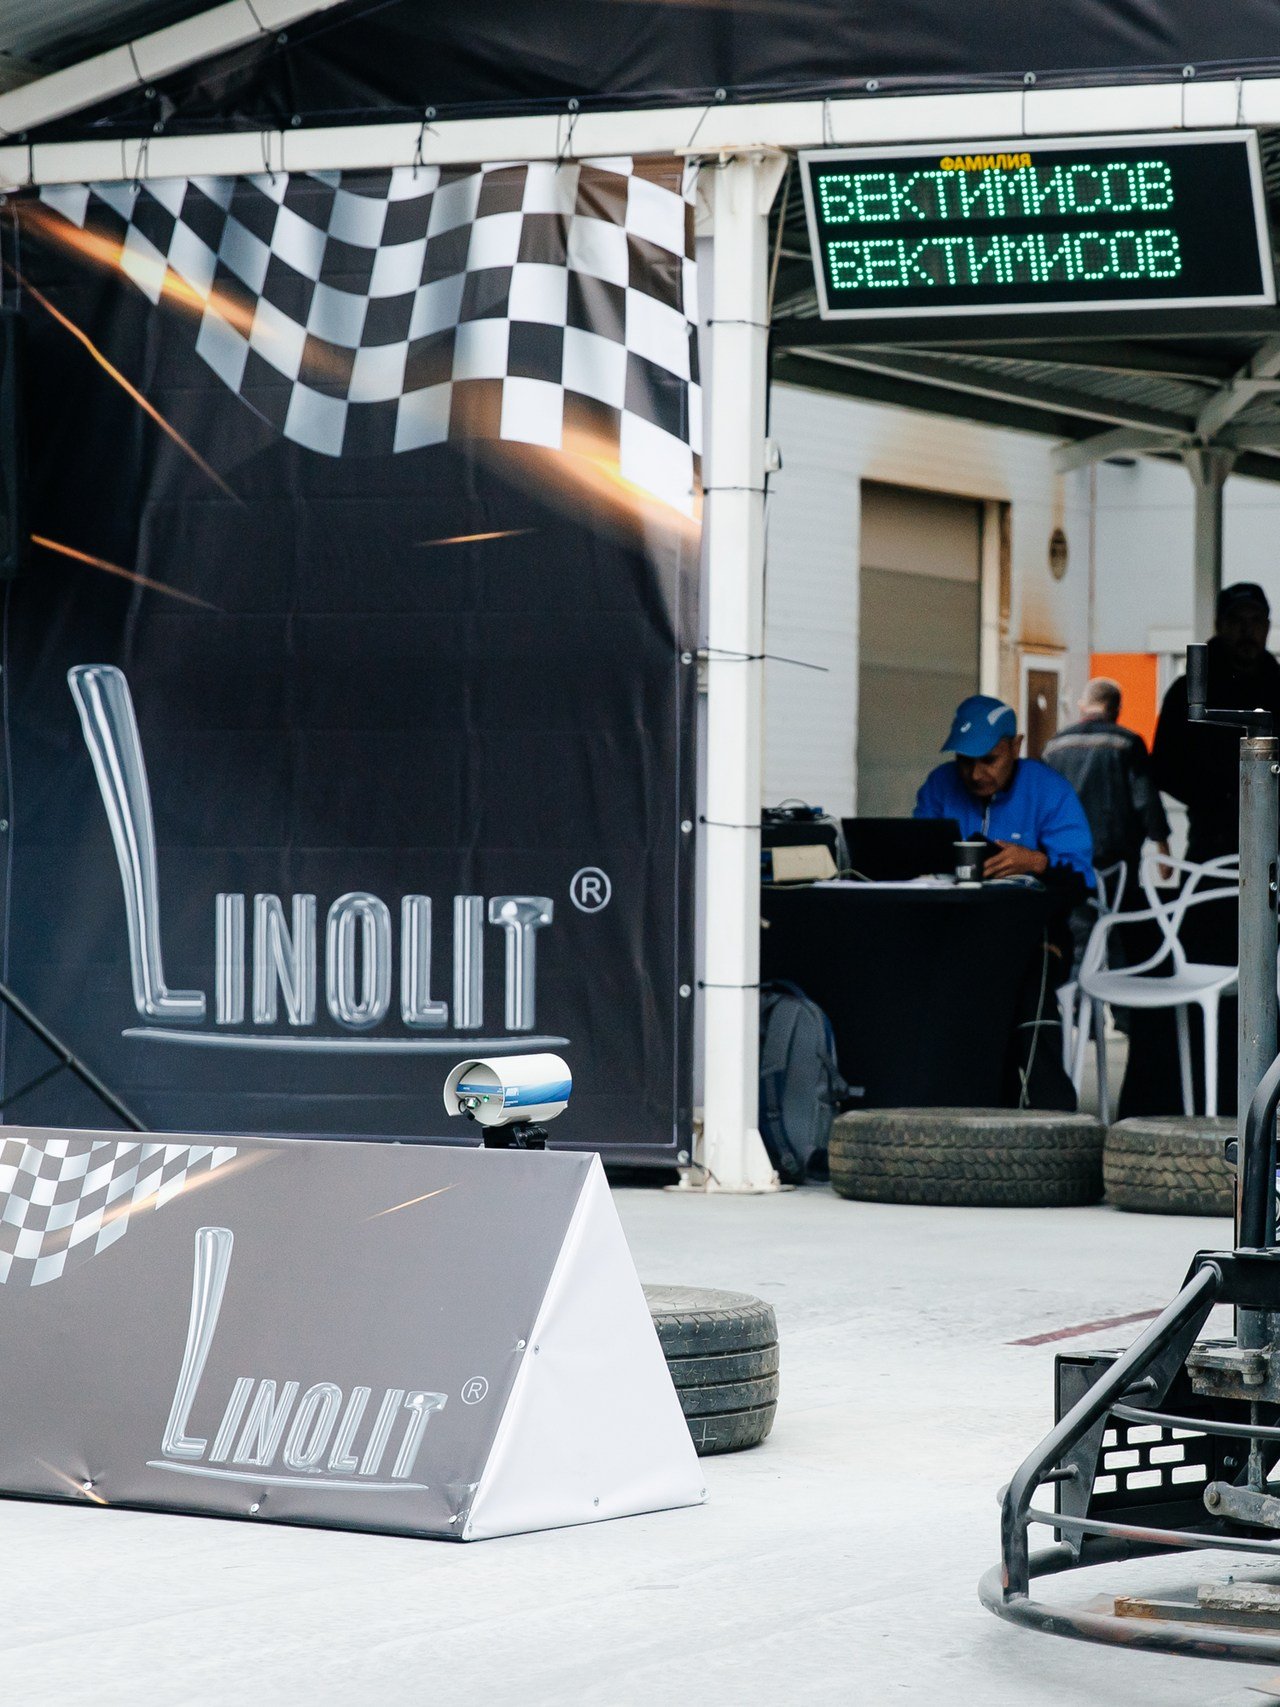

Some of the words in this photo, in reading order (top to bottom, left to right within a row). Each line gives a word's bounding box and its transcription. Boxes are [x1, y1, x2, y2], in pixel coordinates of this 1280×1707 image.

[818, 160, 1175, 224] БЕКТИМИСОВ
[940, 153, 1032, 171] ФАМИЛИЯ
[827, 228, 1183, 290] БЕКТИМИСОВ
[67, 663, 555, 1031] LINOLIT
[160, 1225, 449, 1479] LINOLIT
